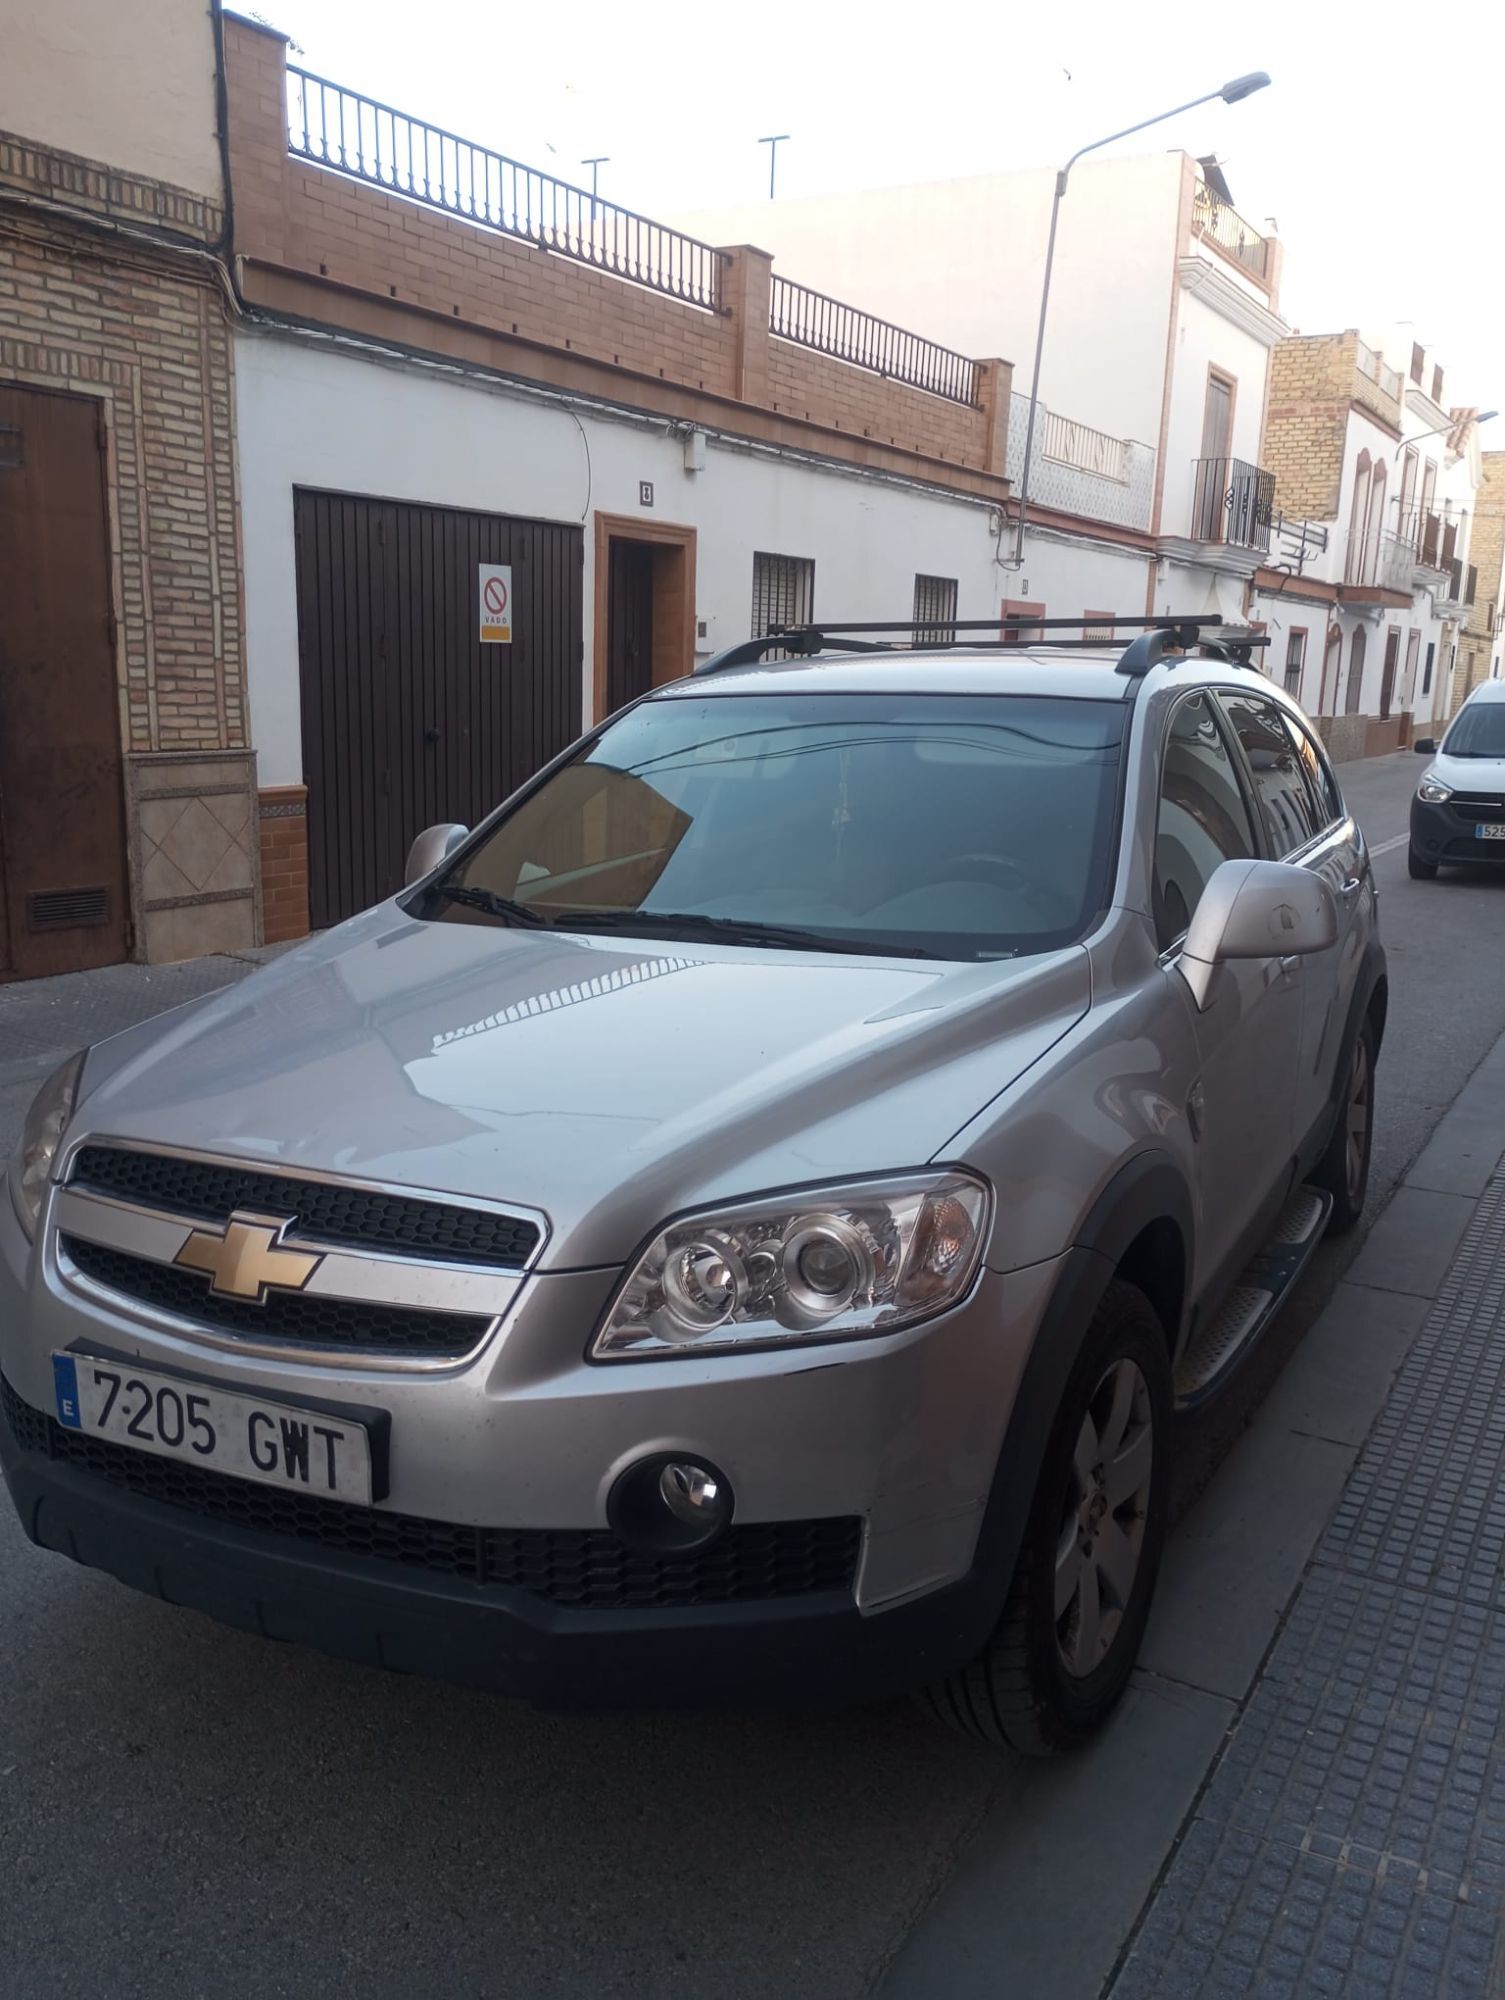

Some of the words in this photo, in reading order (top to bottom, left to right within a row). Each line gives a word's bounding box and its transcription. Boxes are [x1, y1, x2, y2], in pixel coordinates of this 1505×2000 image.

[485, 616, 507, 624] VADO
[63, 1399, 74, 1417] E
[94, 1369, 216, 1455] 7205
[249, 1411, 345, 1490] GWT
